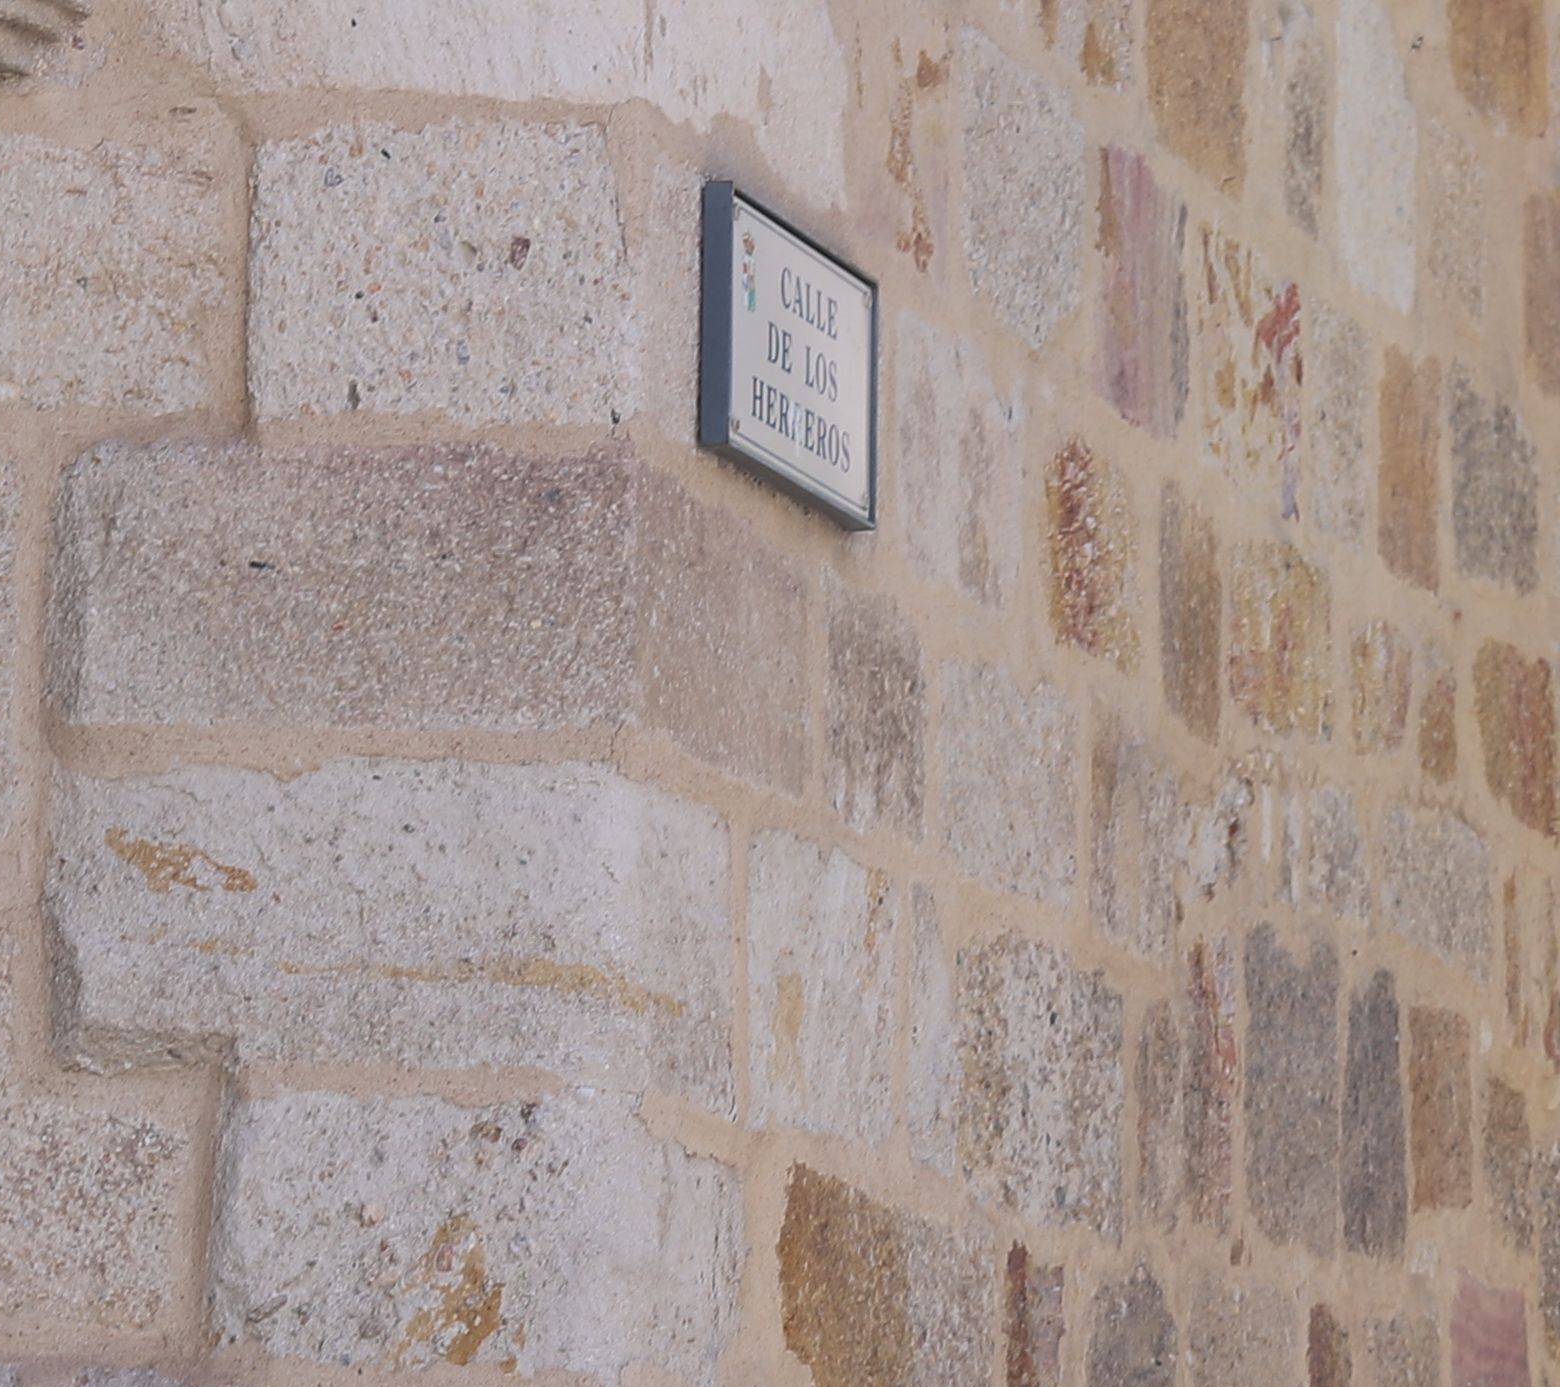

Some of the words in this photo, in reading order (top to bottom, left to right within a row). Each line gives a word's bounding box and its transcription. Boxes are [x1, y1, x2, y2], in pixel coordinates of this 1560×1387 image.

[780, 267, 838, 341] CALLE
[767, 321, 792, 374] DE
[805, 345, 838, 403] LOS
[751, 376, 850, 474] HERREROS
